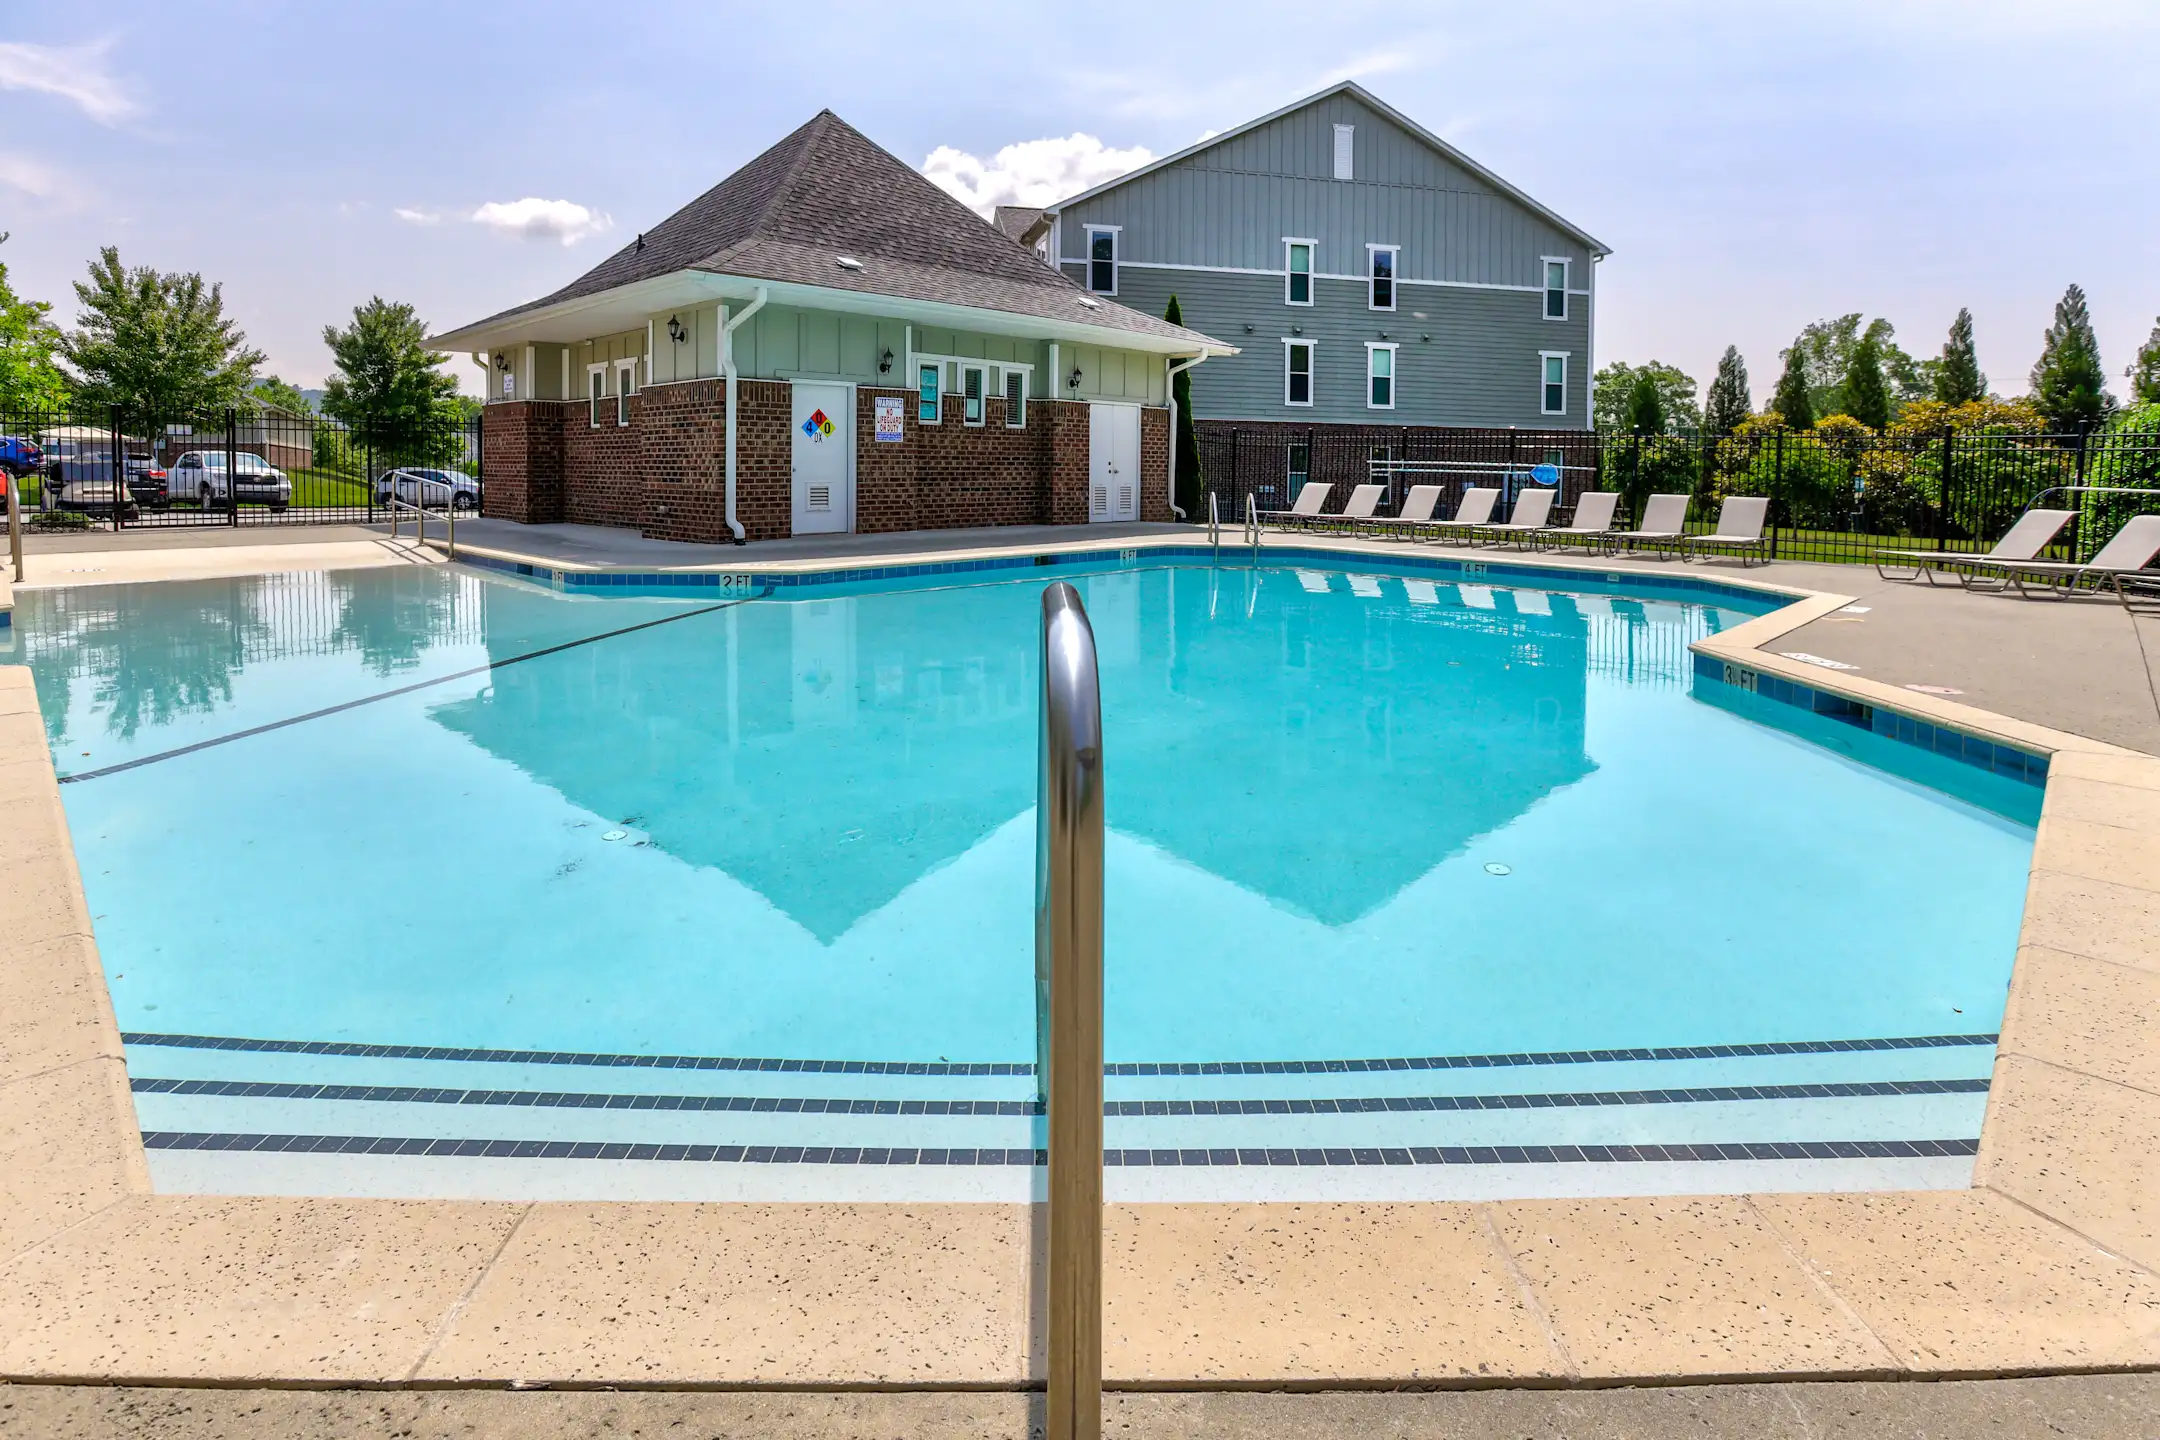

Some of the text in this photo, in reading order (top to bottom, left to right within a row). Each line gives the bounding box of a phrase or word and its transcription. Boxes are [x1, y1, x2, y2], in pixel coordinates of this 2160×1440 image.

[876, 398, 903, 408] WARNING
[815, 412, 823, 424] 0
[877, 415, 902, 424] LIFEGUARD
[806, 421, 813, 433] 4
[824, 422, 831, 434] 0
[887, 424, 899, 433] DUTY
[1474, 564, 1486, 573] FT
[723, 575, 750, 588] 2 FT
[1740, 669, 1755, 693] FT
